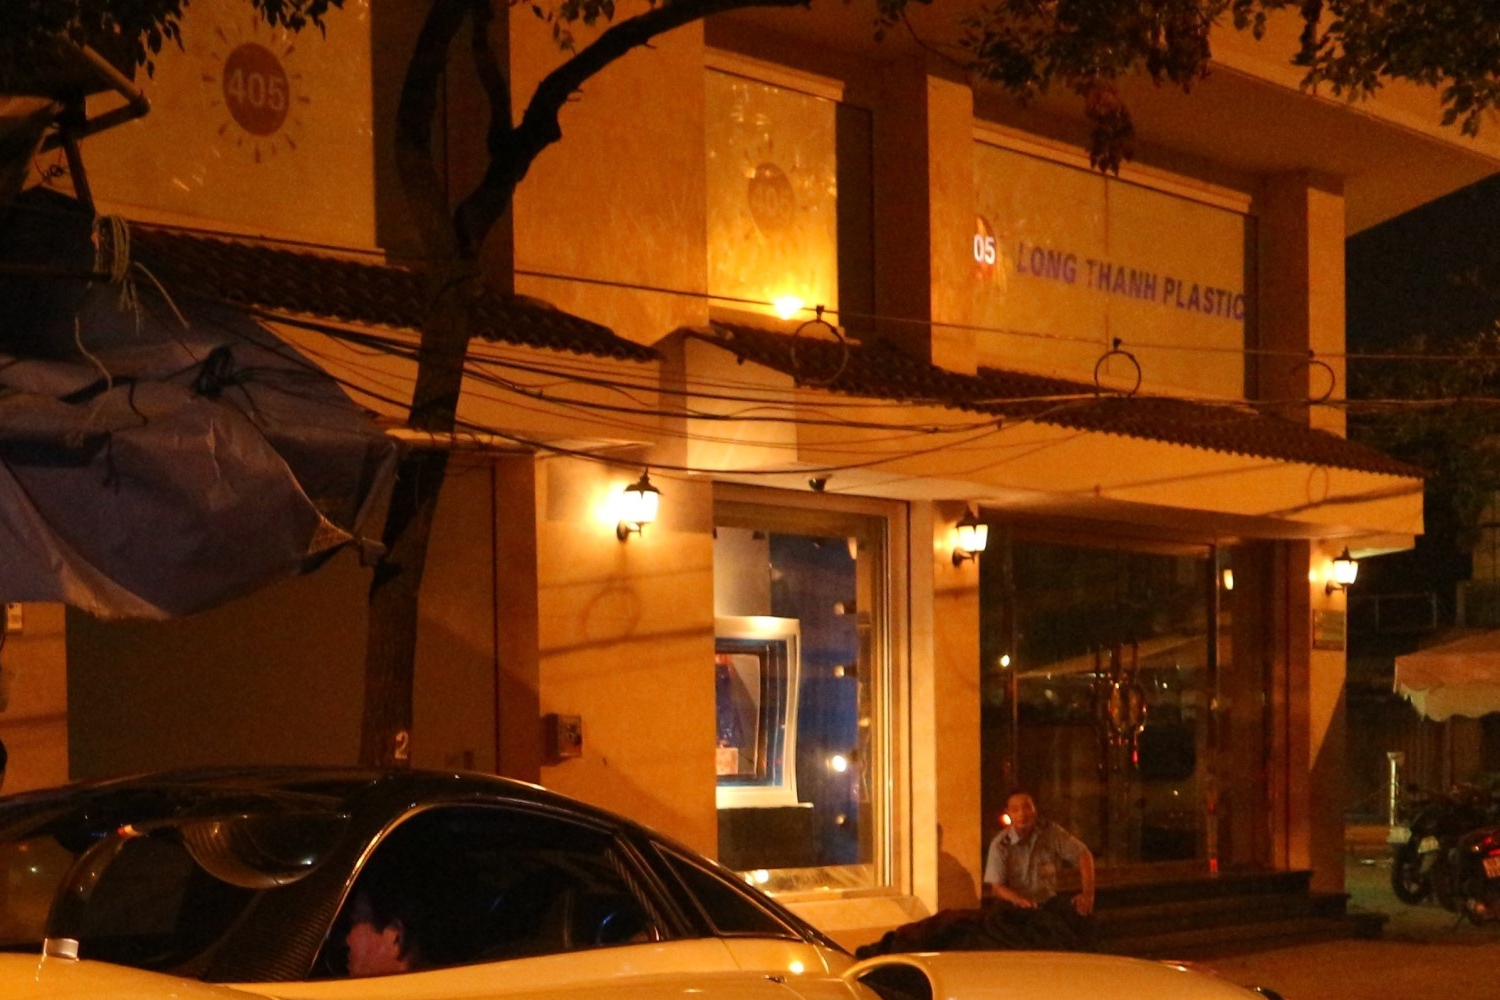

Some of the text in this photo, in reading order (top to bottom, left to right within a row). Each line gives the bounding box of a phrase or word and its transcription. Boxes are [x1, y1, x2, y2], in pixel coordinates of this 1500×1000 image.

[228, 68, 285, 111] 405
[1016, 241, 1245, 321] LONG THANH PLASTIC
